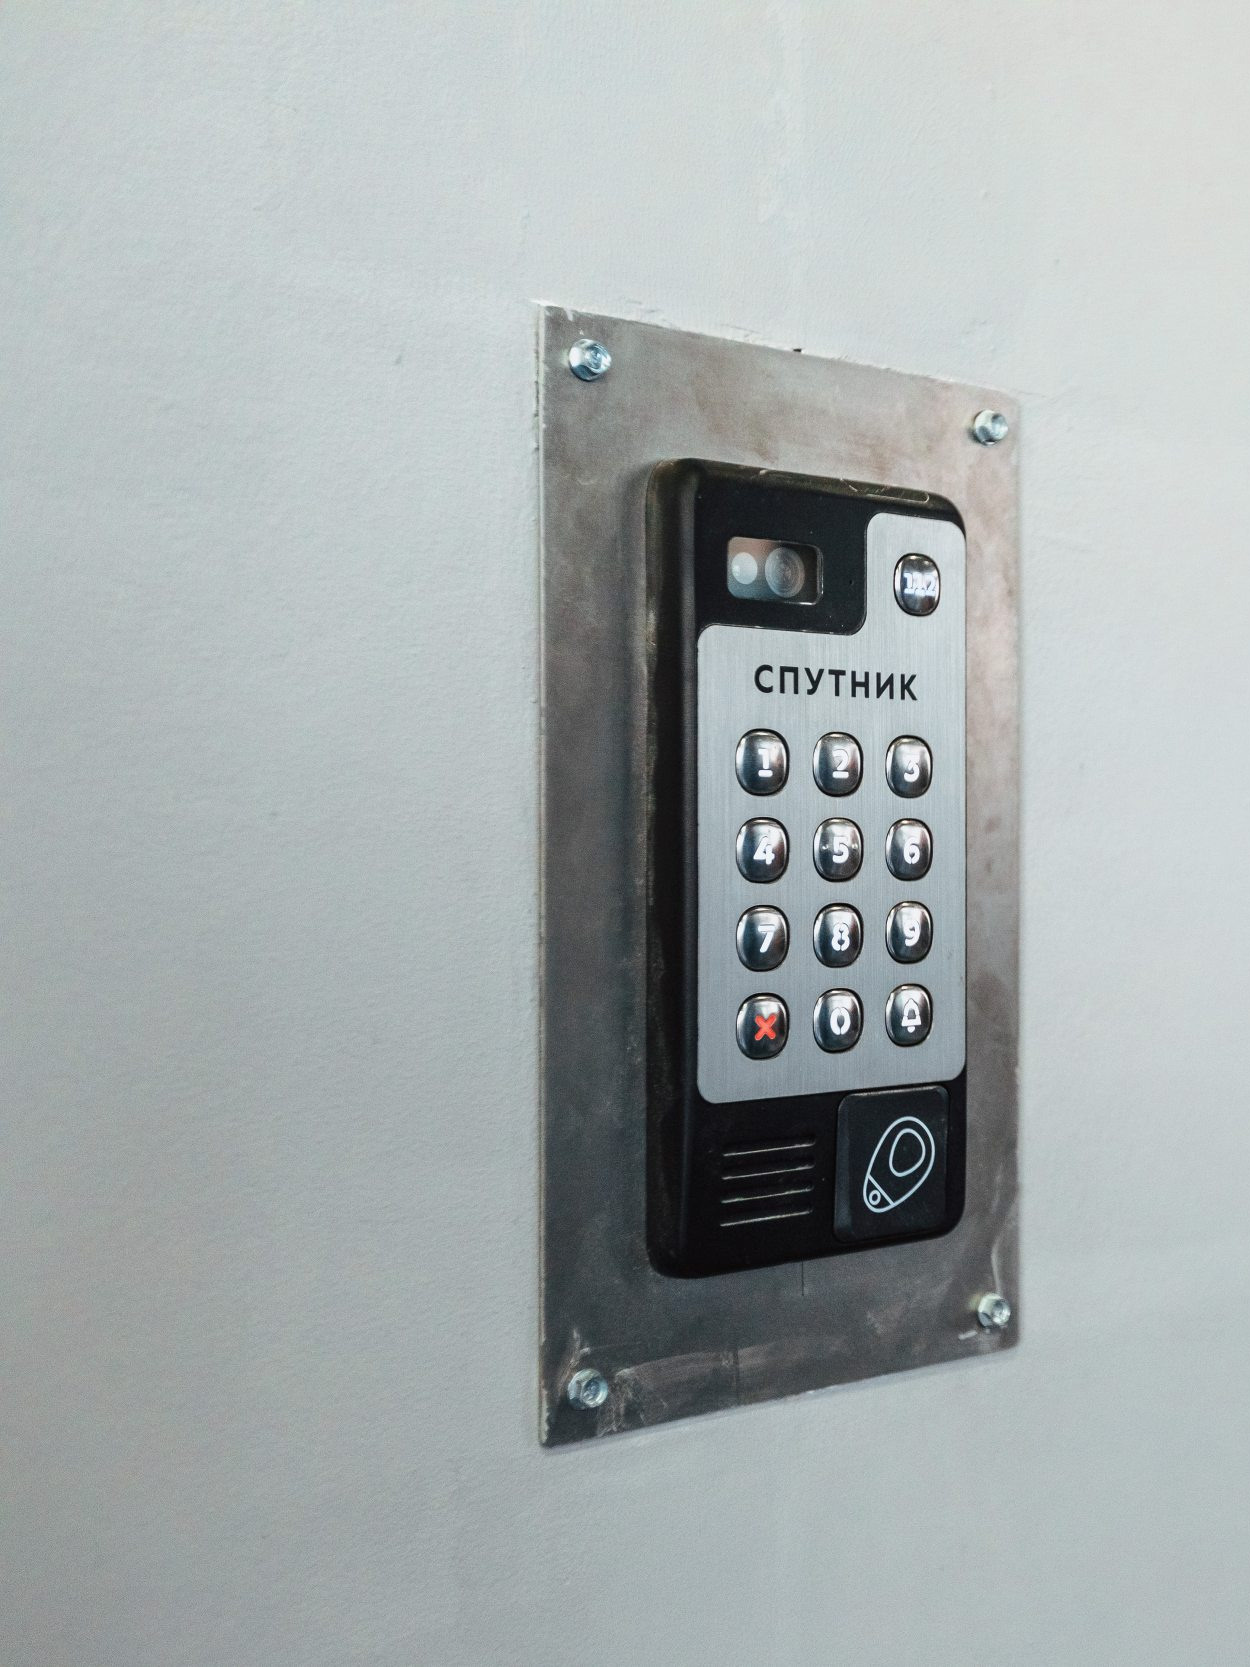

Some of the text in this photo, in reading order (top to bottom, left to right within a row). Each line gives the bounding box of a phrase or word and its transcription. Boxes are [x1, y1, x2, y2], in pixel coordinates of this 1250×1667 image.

[754, 664, 918, 701] СПУТНИК
[757, 748, 920, 783] 1 2 3
[753, 835, 921, 865] 4 5 6
[757, 919, 921, 953] 7 8 9
[829, 1006, 851, 1036] 0
